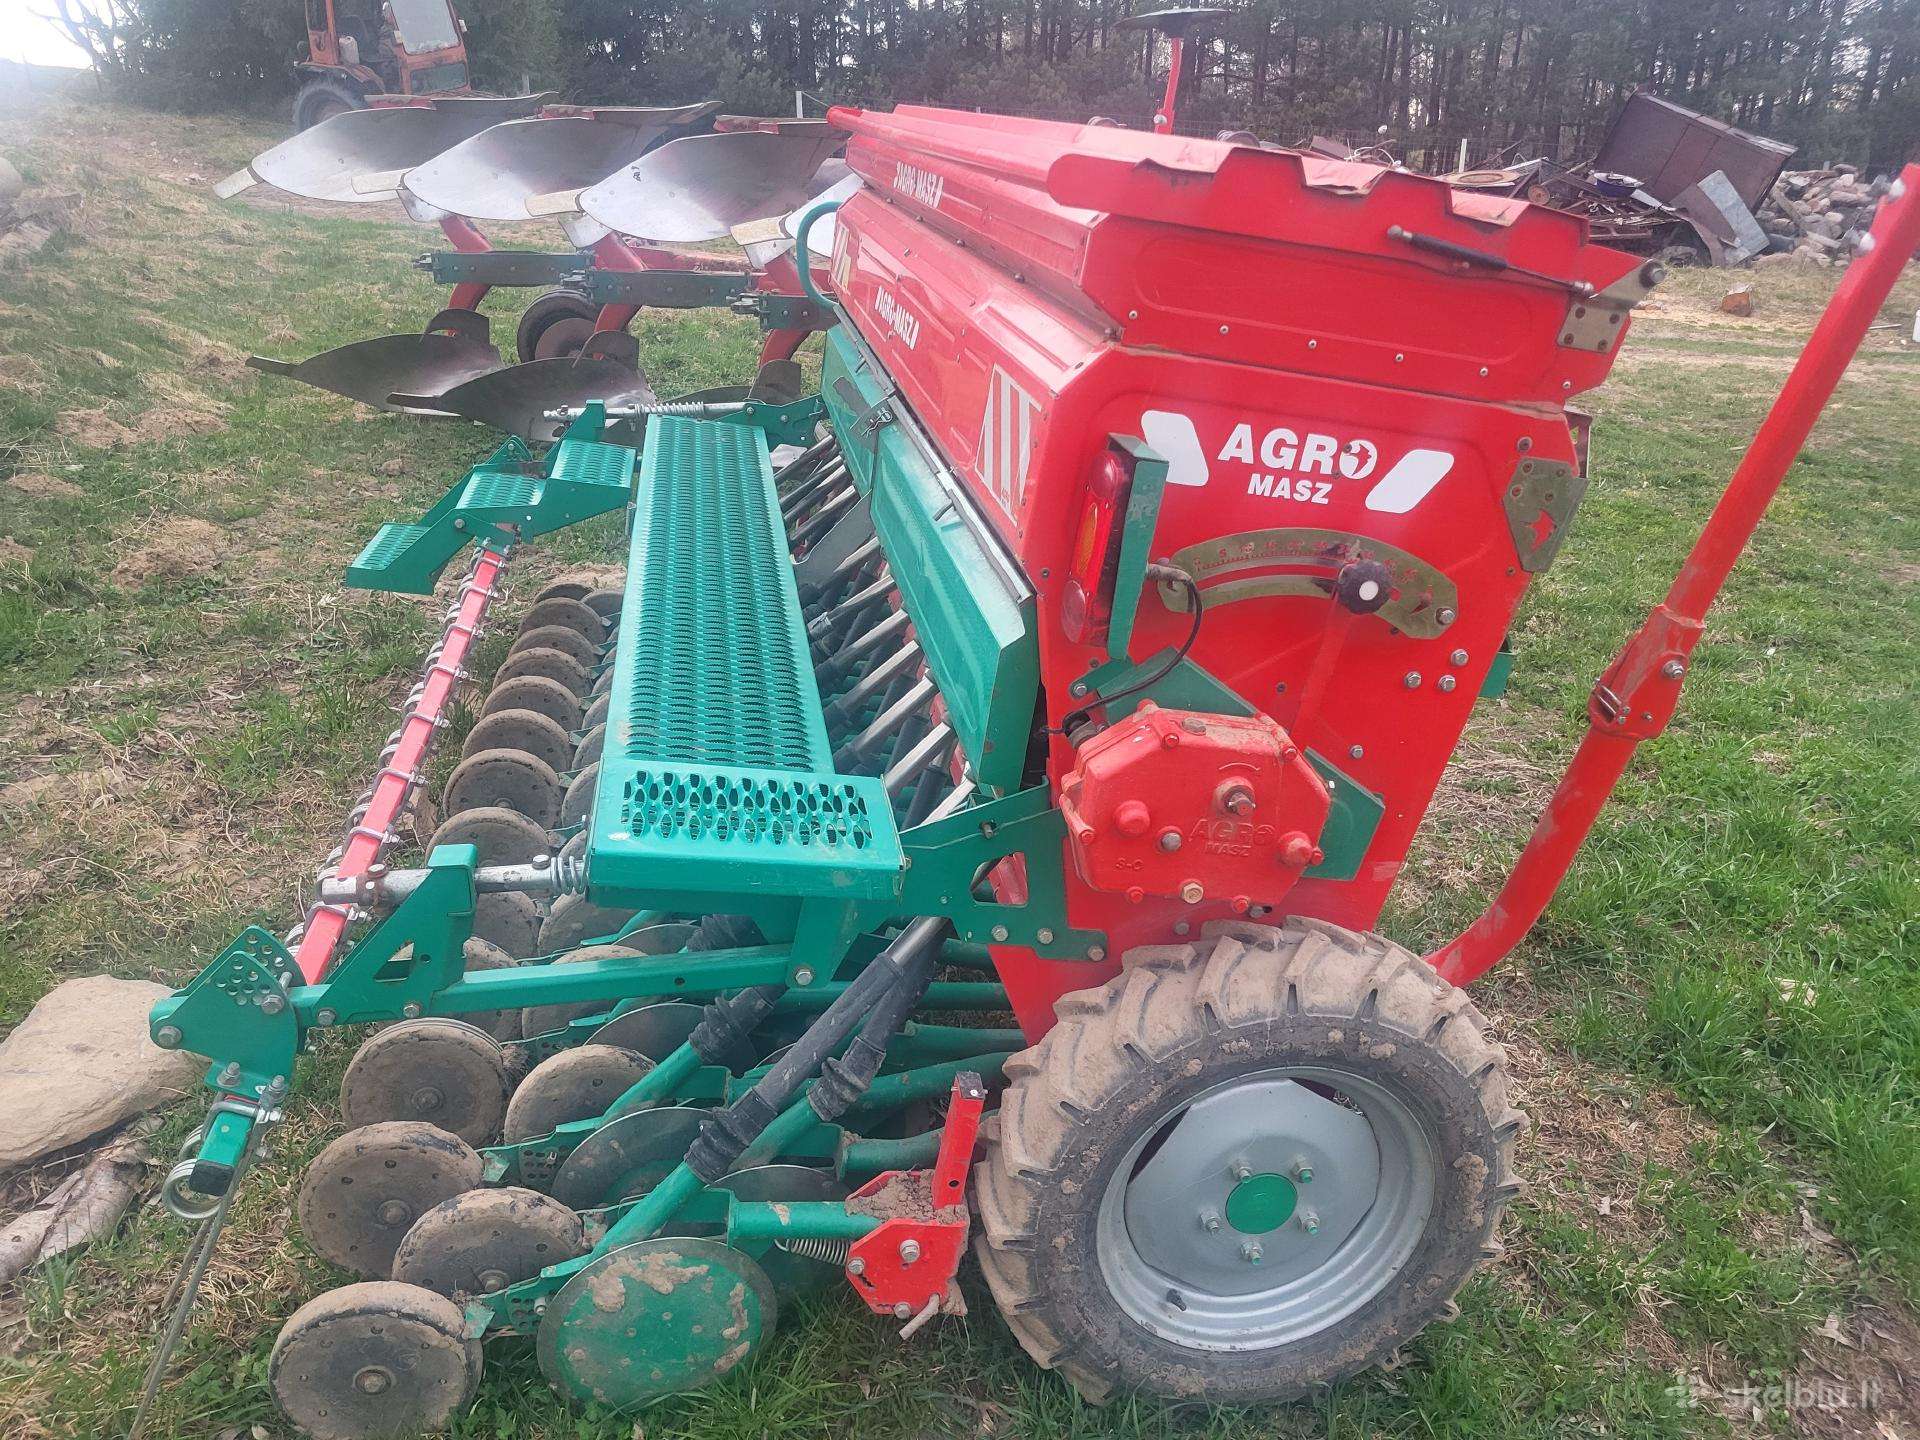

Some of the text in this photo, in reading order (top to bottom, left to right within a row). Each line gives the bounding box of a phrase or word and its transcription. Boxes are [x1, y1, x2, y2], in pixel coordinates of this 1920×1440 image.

[1218, 422, 1379, 480] AGRO
[1247, 474, 1333, 505] MASZ
[1188, 818, 1275, 847] AGRO
